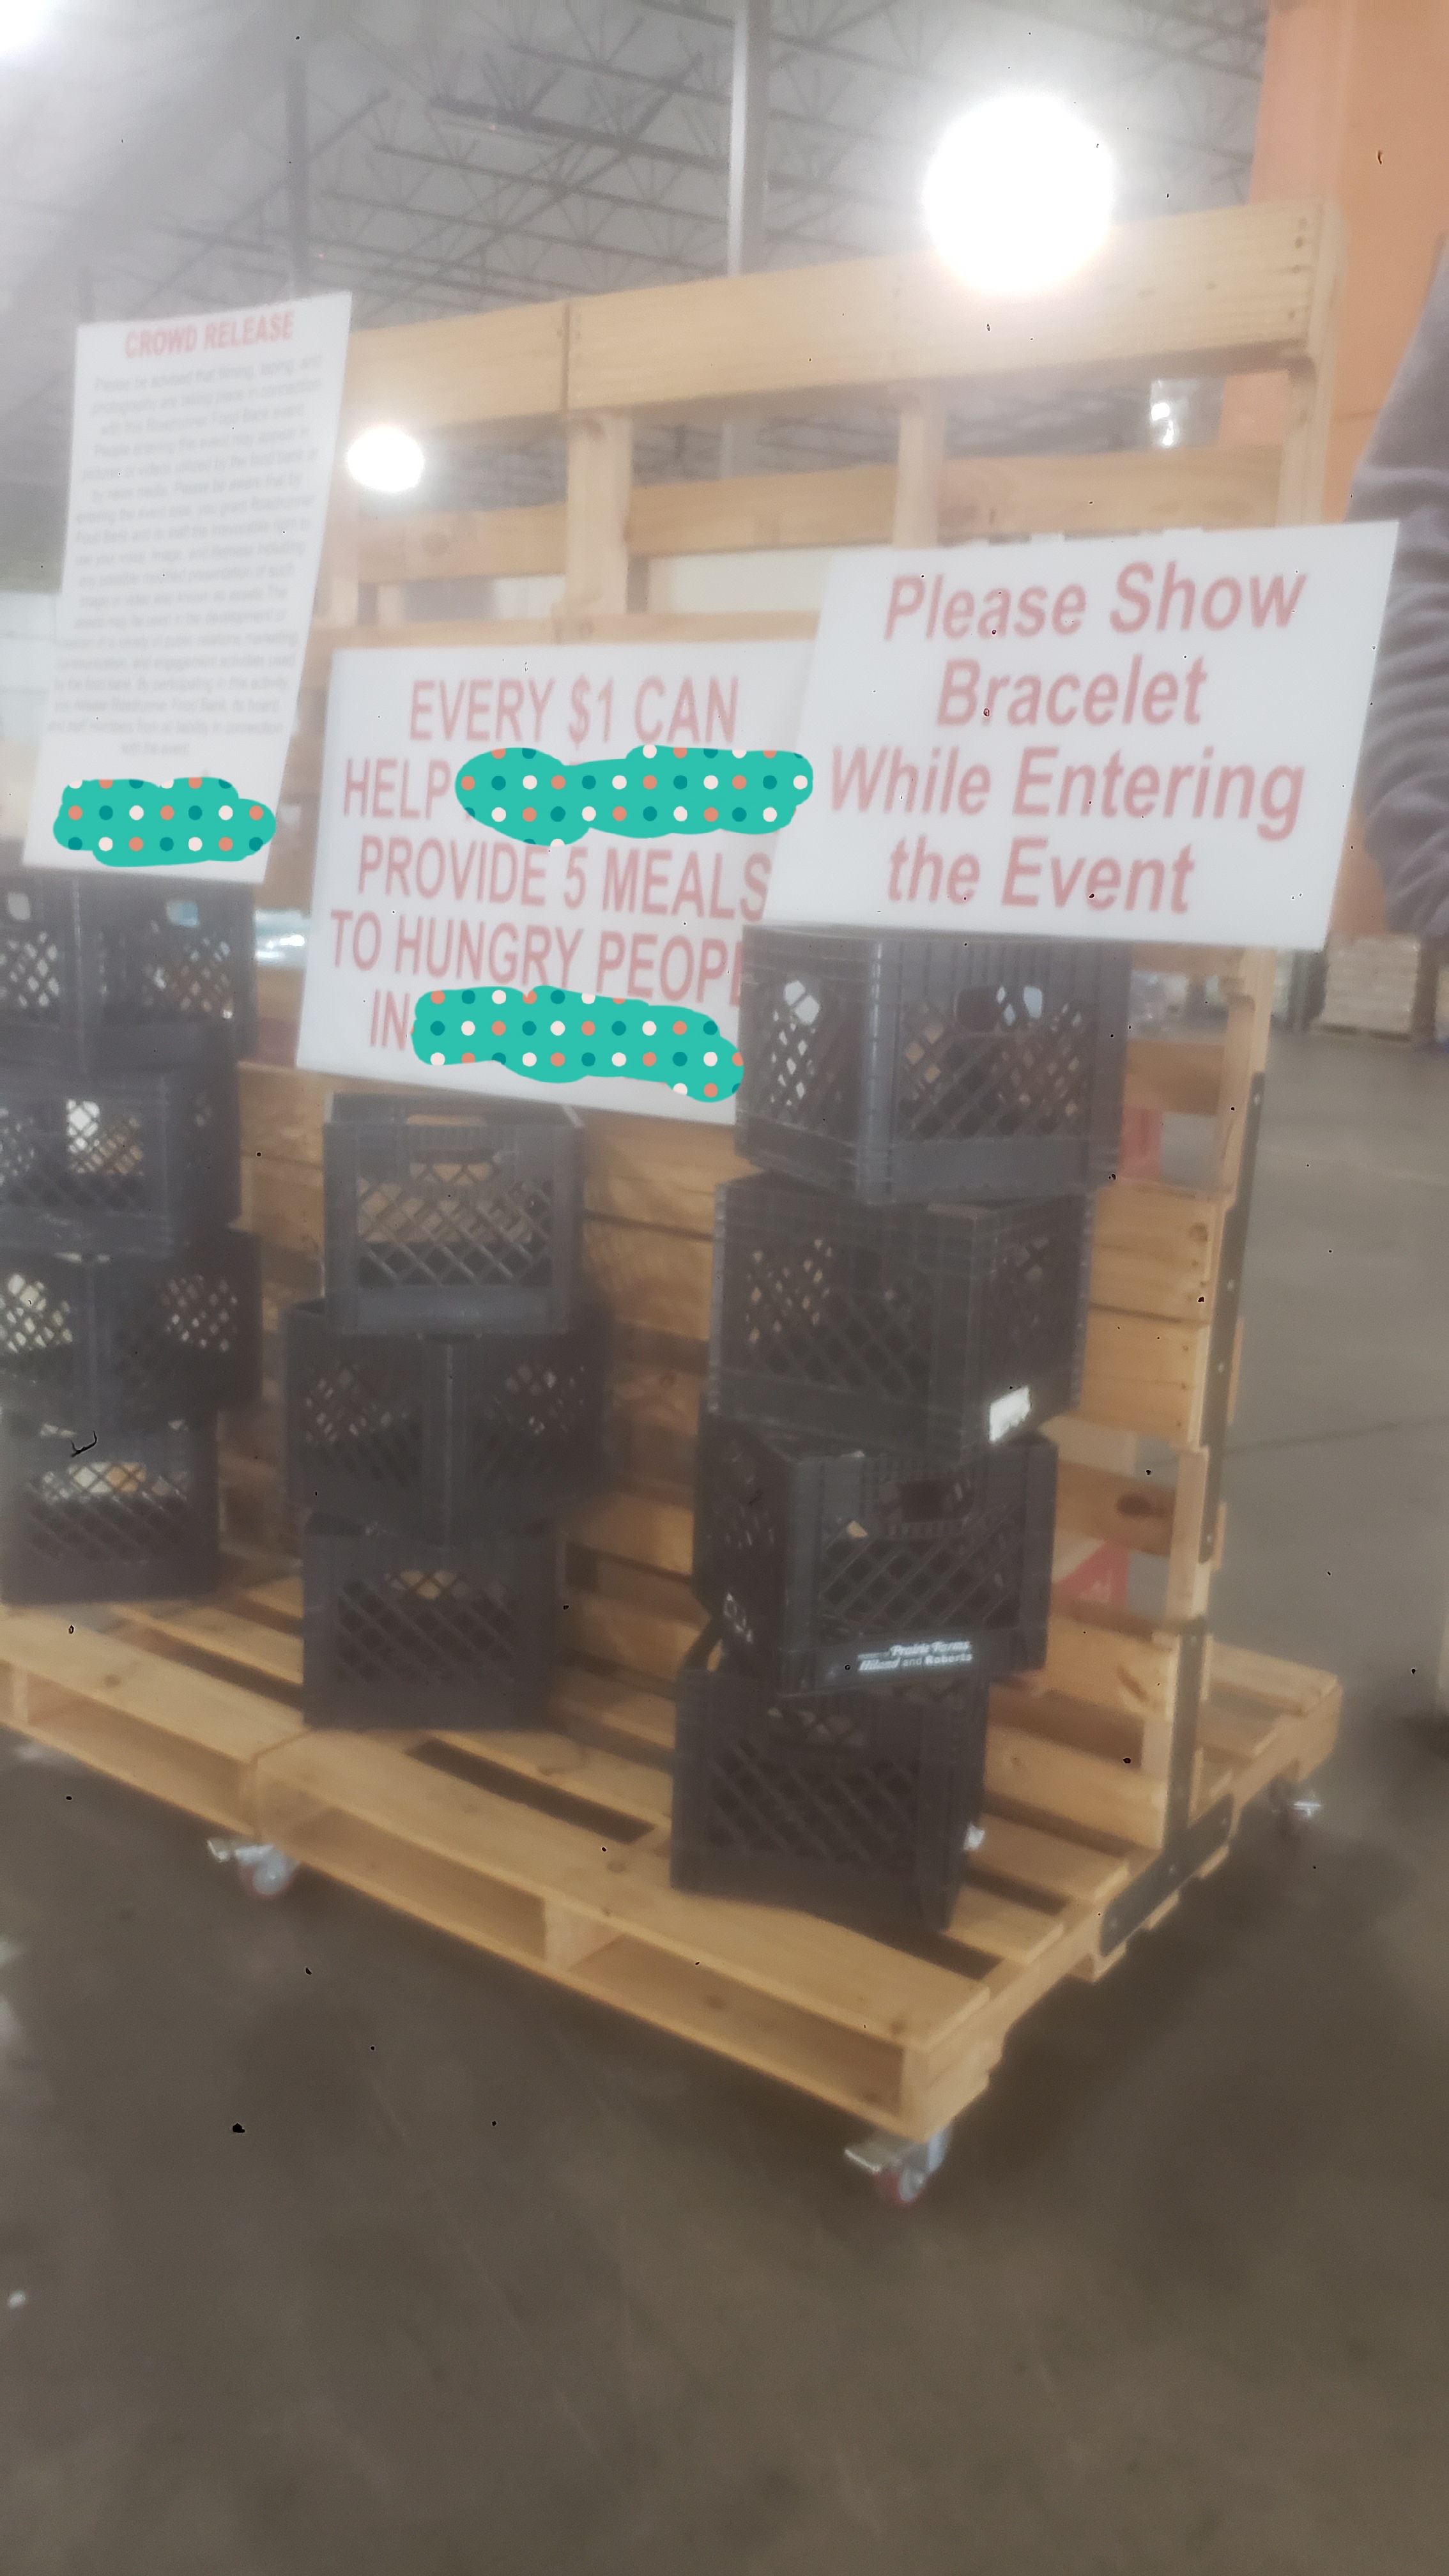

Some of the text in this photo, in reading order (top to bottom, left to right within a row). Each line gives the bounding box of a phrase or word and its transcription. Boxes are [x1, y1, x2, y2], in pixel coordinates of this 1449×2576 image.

[125, 311, 293, 358] CROWD RELEASE
[885, 561, 1307, 640] Please Show
[410, 675, 738, 748] EVERY $1 CAN
[937, 654, 1207, 727] Bracelet
[344, 758, 452, 820] HELP
[831, 746, 1305, 847] While Entering
[358, 836, 770, 924] PROVIDE 5 MEALS
[888, 836, 1195, 914] the Event
[330, 909, 382, 971] TO
[395, 916, 583, 988] HUNGRY
[370, 992, 410, 1050] IN
